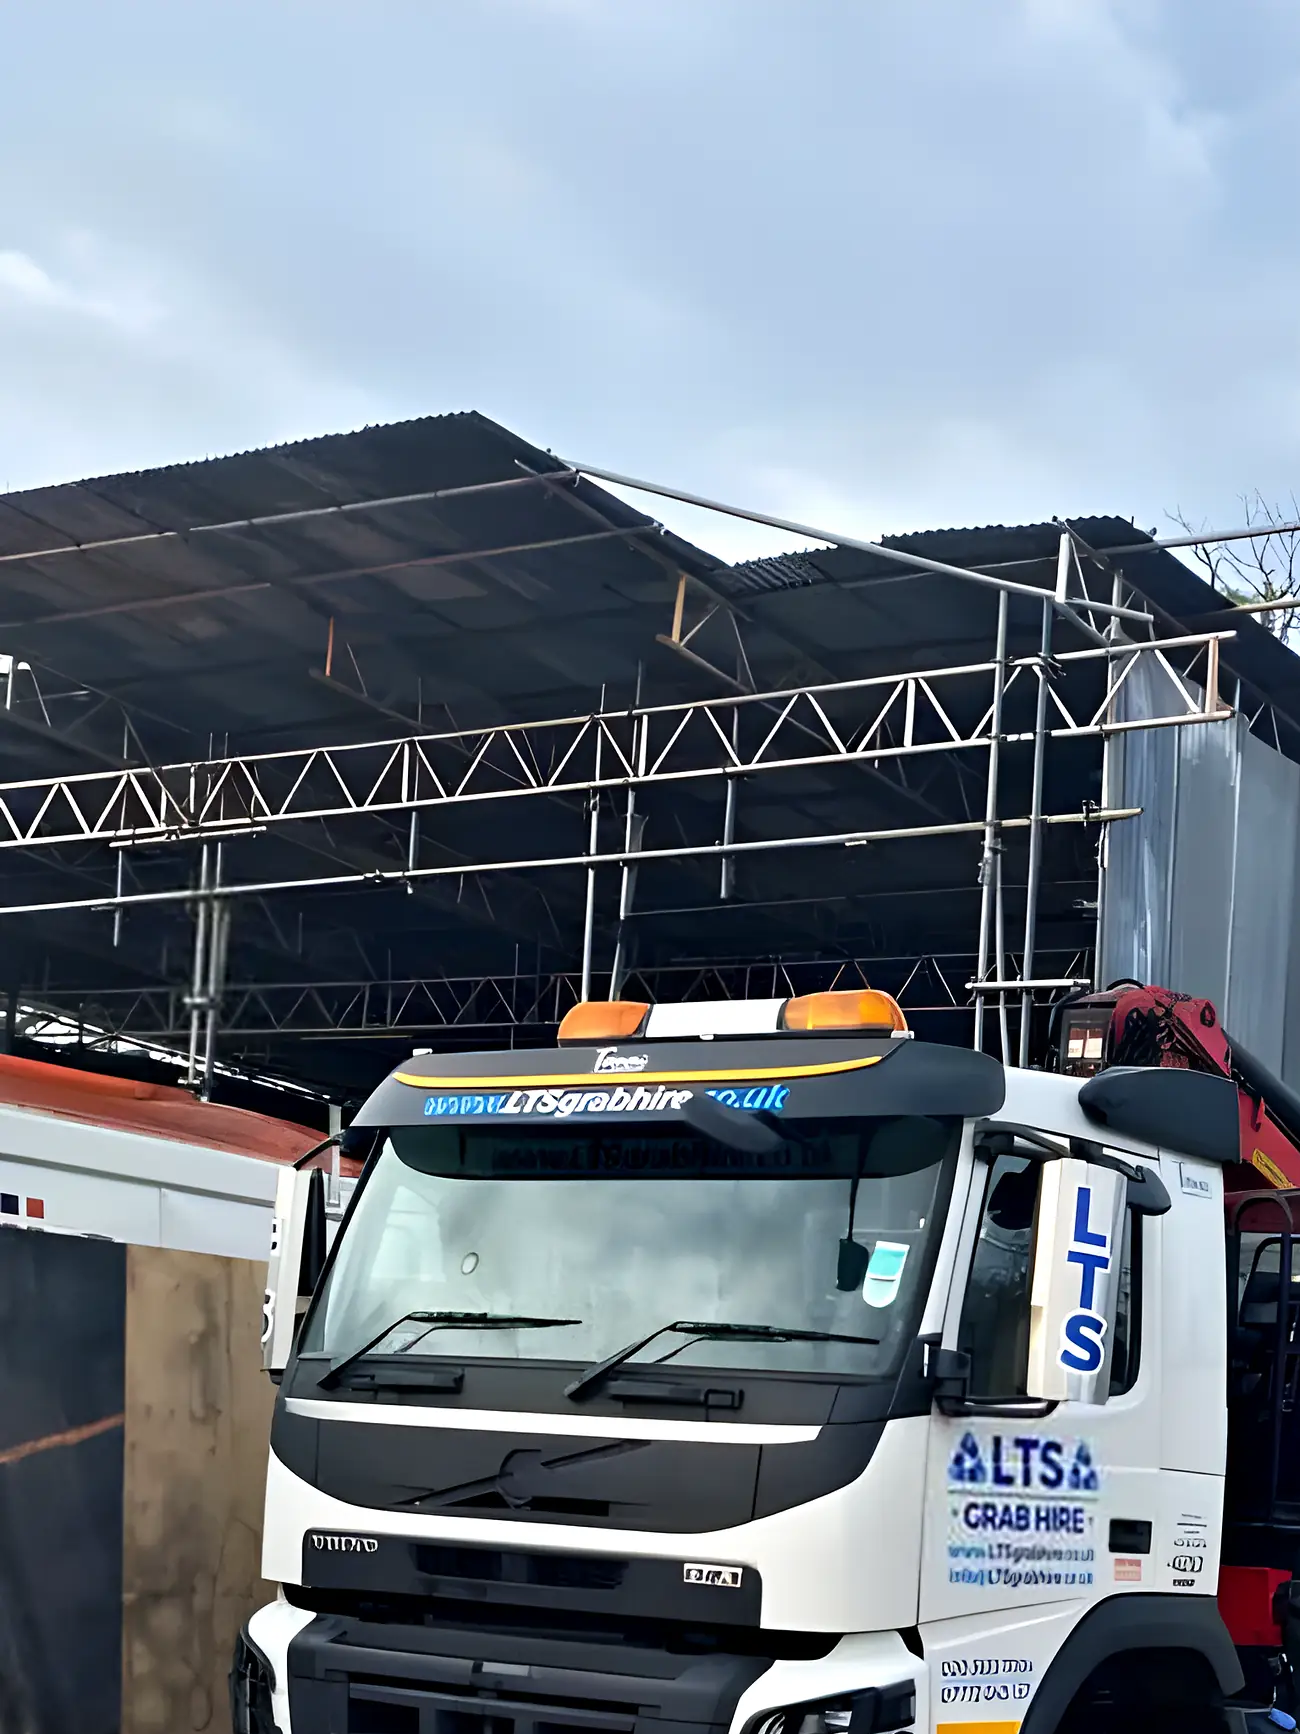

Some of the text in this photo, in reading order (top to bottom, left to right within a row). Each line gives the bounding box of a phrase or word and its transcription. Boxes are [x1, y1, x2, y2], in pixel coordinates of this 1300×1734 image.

[1060, 1187, 1110, 1371] LTS
[992, 1435, 1065, 1490] LTS
[963, 1502, 1085, 1534] GRAB HIRE
